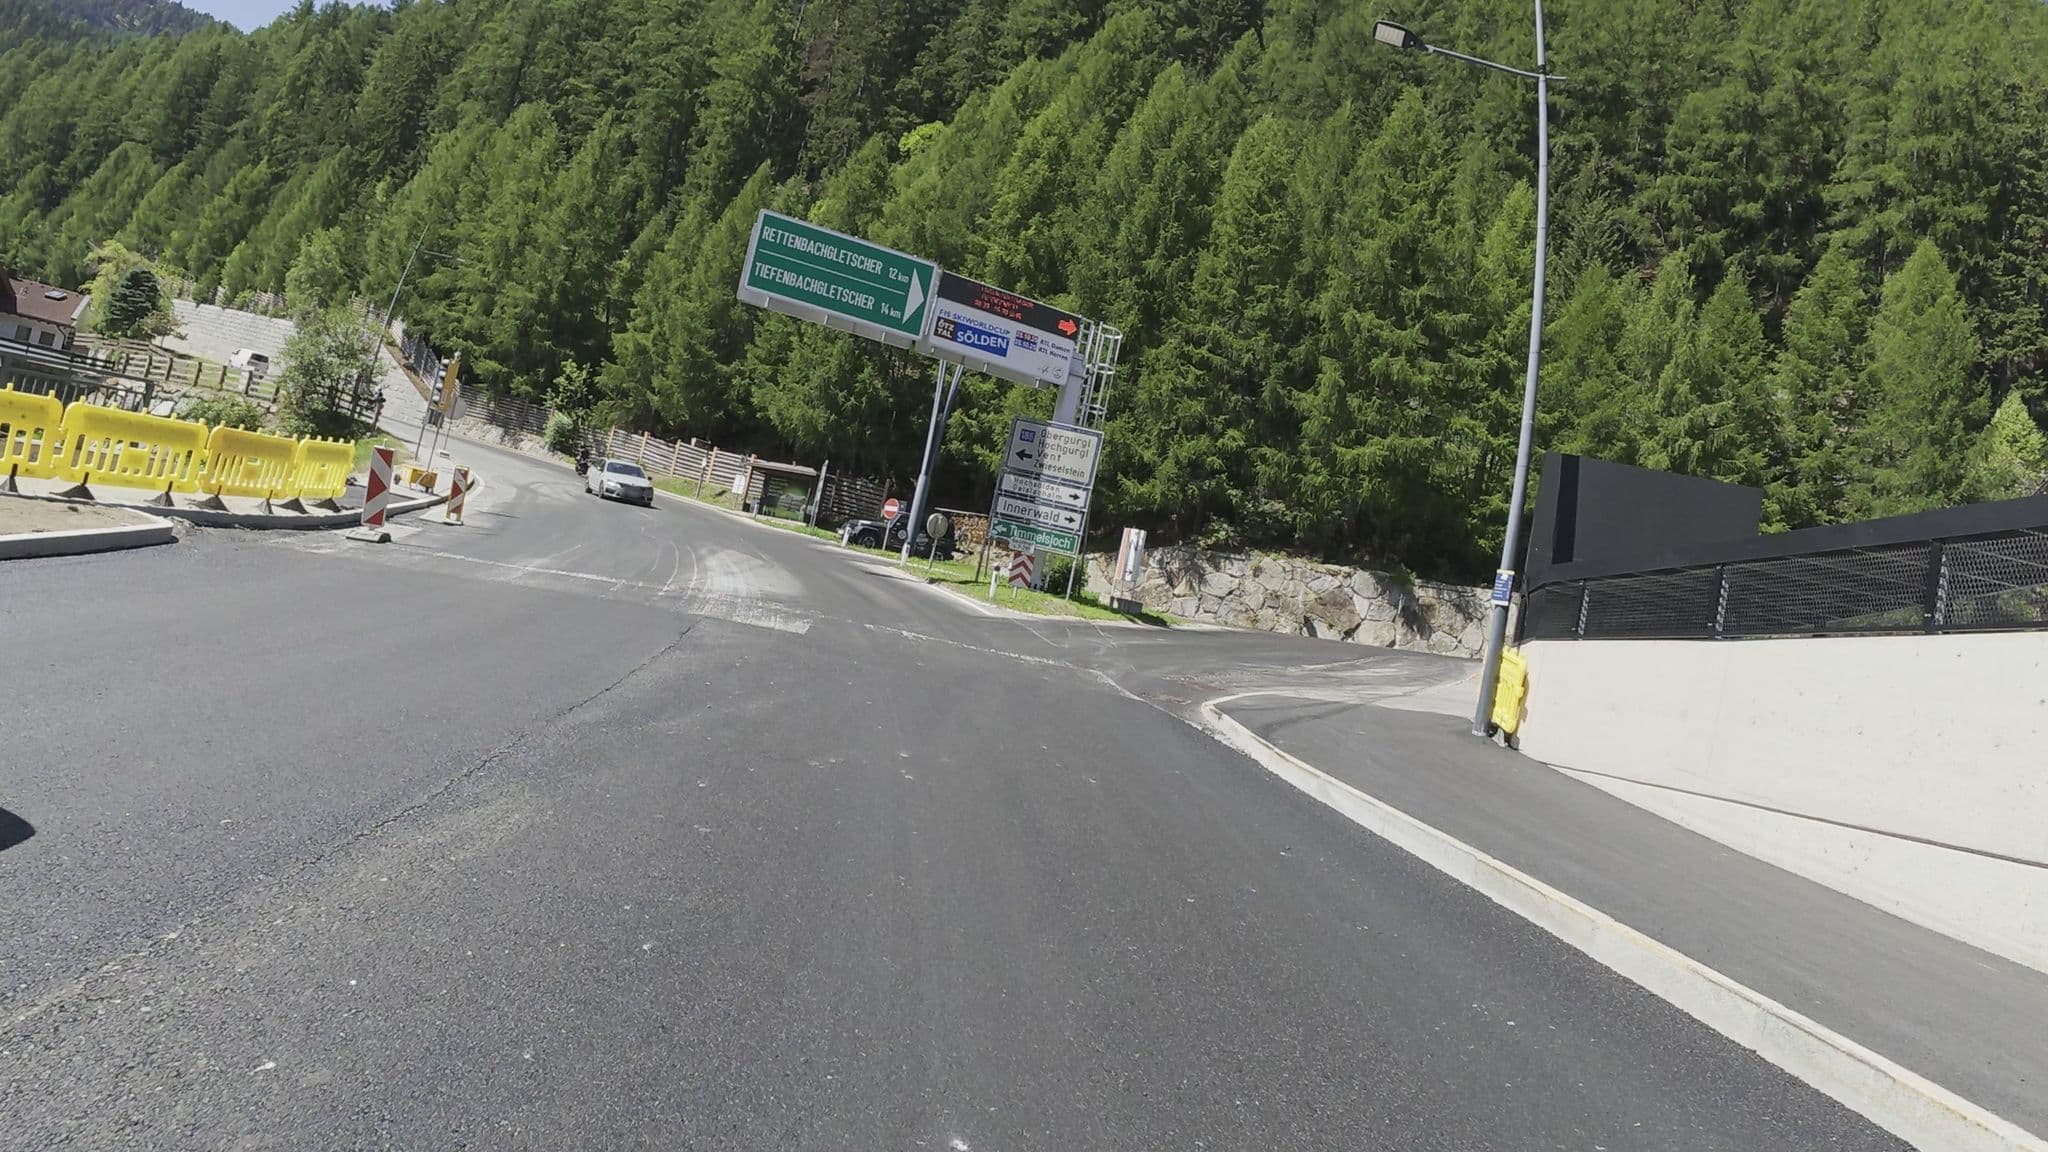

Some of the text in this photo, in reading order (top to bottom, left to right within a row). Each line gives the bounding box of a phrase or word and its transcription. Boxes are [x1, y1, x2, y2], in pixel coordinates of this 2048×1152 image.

[762, 225, 909, 283] RETTENBACHGLETSCHER 12 km
[755, 262, 901, 319] TIEFENBACHGLETSCHER 14 km
[939, 308, 1011, 335] FIS SKIWORLDCUP
[937, 327, 953, 339] TAL
[957, 330, 1008, 349] SÖLDEN
[1041, 429, 1092, 447] Obergurgl
[1037, 450, 1062, 461] Vent
[1039, 439, 1089, 458] Hochgurgl
[1033, 460, 1086, 478] Zwieselstein
[1003, 501, 1060, 522] Innerwald
[1009, 525, 1071, 549] Timmelsjoch
